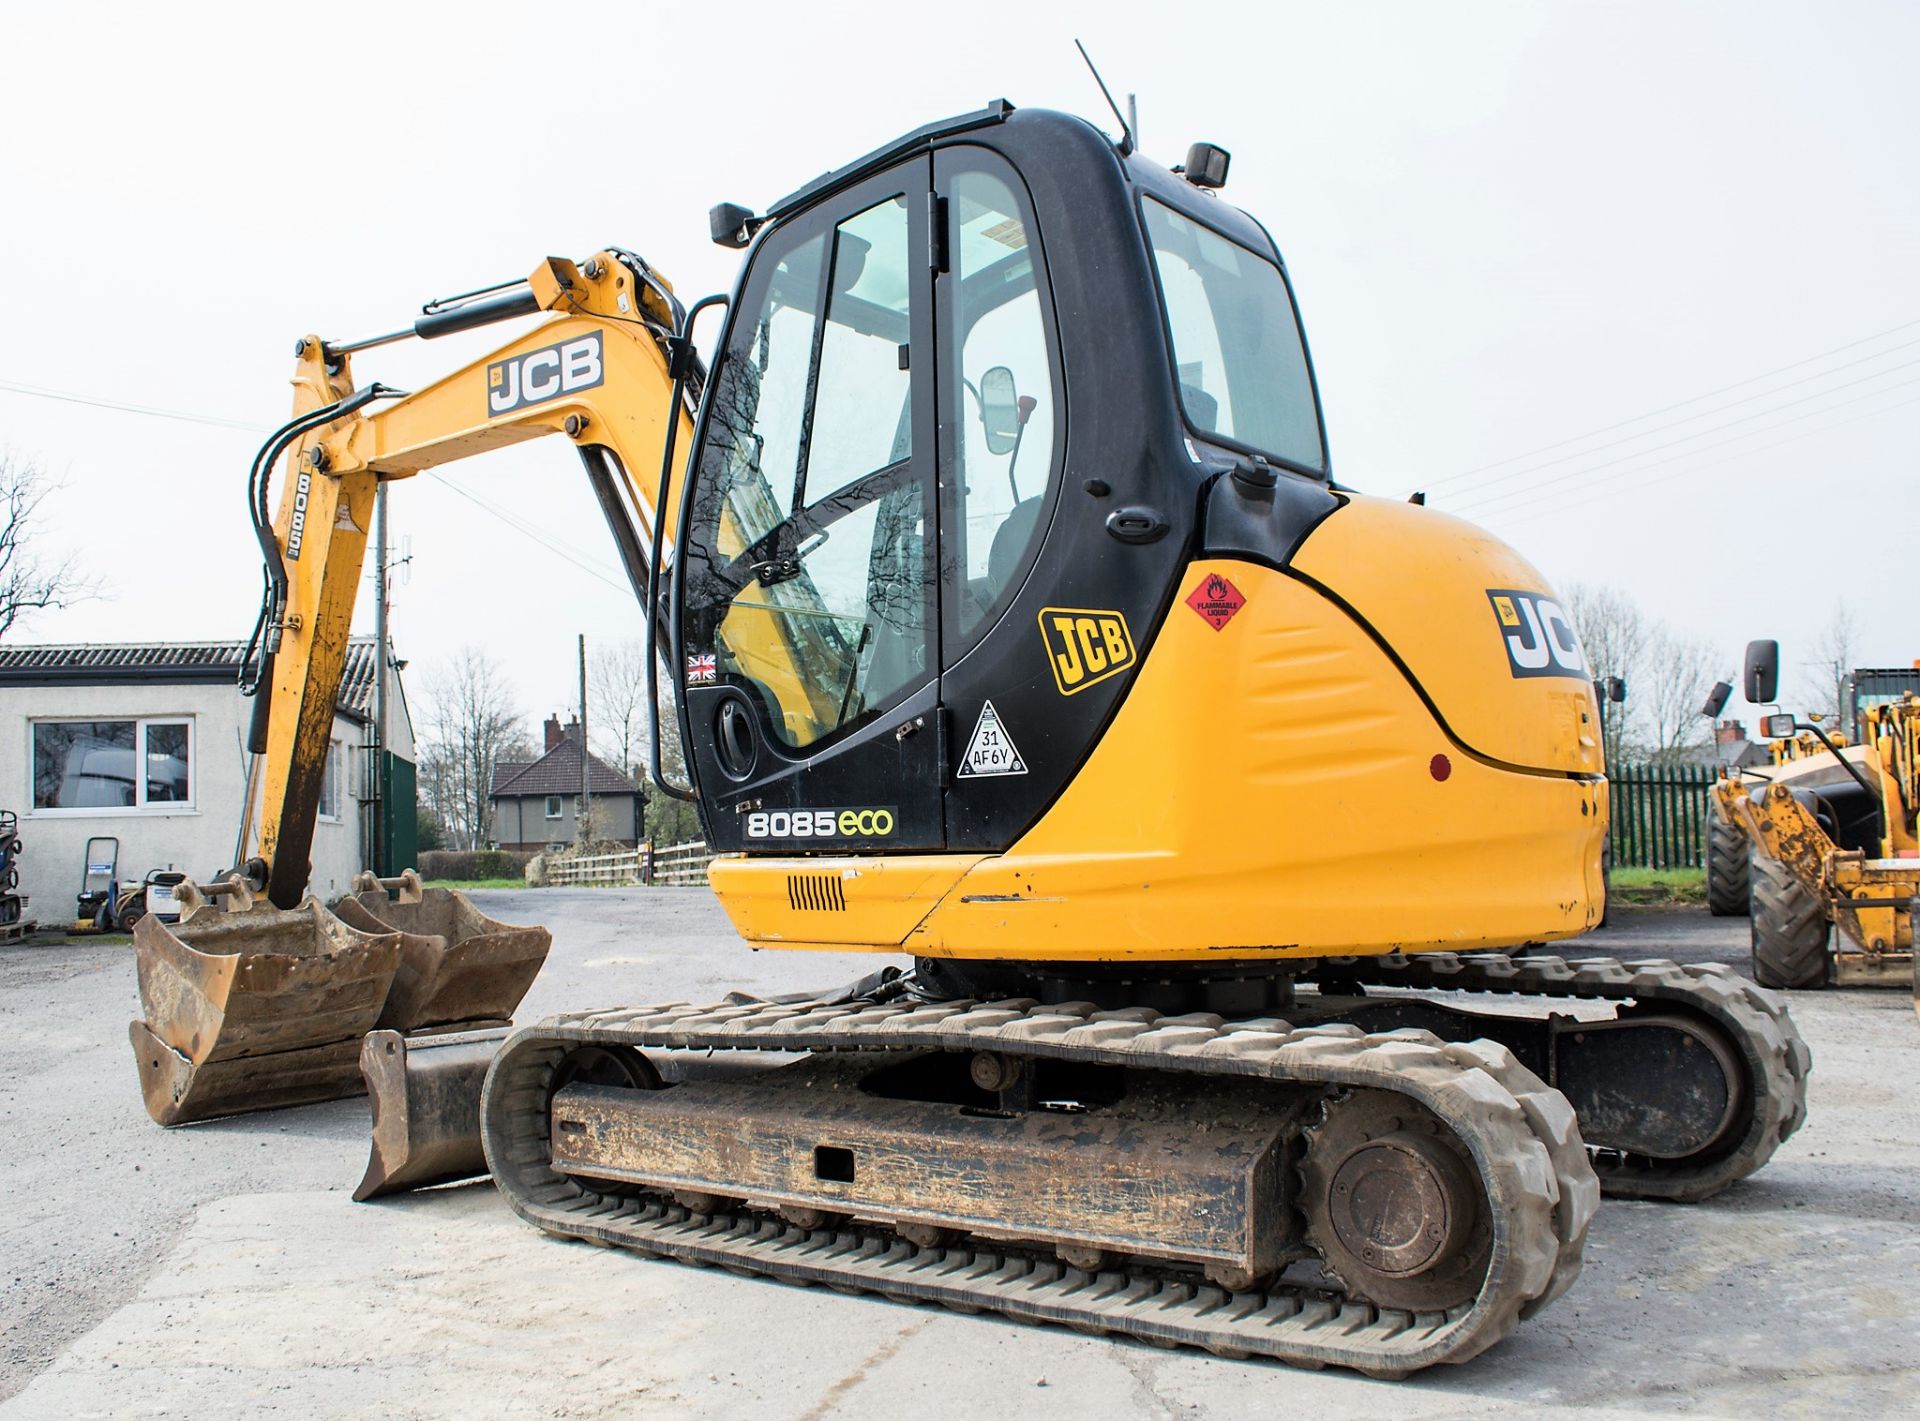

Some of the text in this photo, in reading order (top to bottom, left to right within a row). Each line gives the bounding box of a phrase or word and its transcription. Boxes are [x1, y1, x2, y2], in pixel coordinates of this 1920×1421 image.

[490, 337, 602, 412] JCB
[288, 473, 312, 550] 8085
[1207, 609, 1229, 617] LIQUID
[1215, 618, 1221, 626] 3
[1052, 617, 1128, 685] JCB
[982, 730, 999, 747] 31
